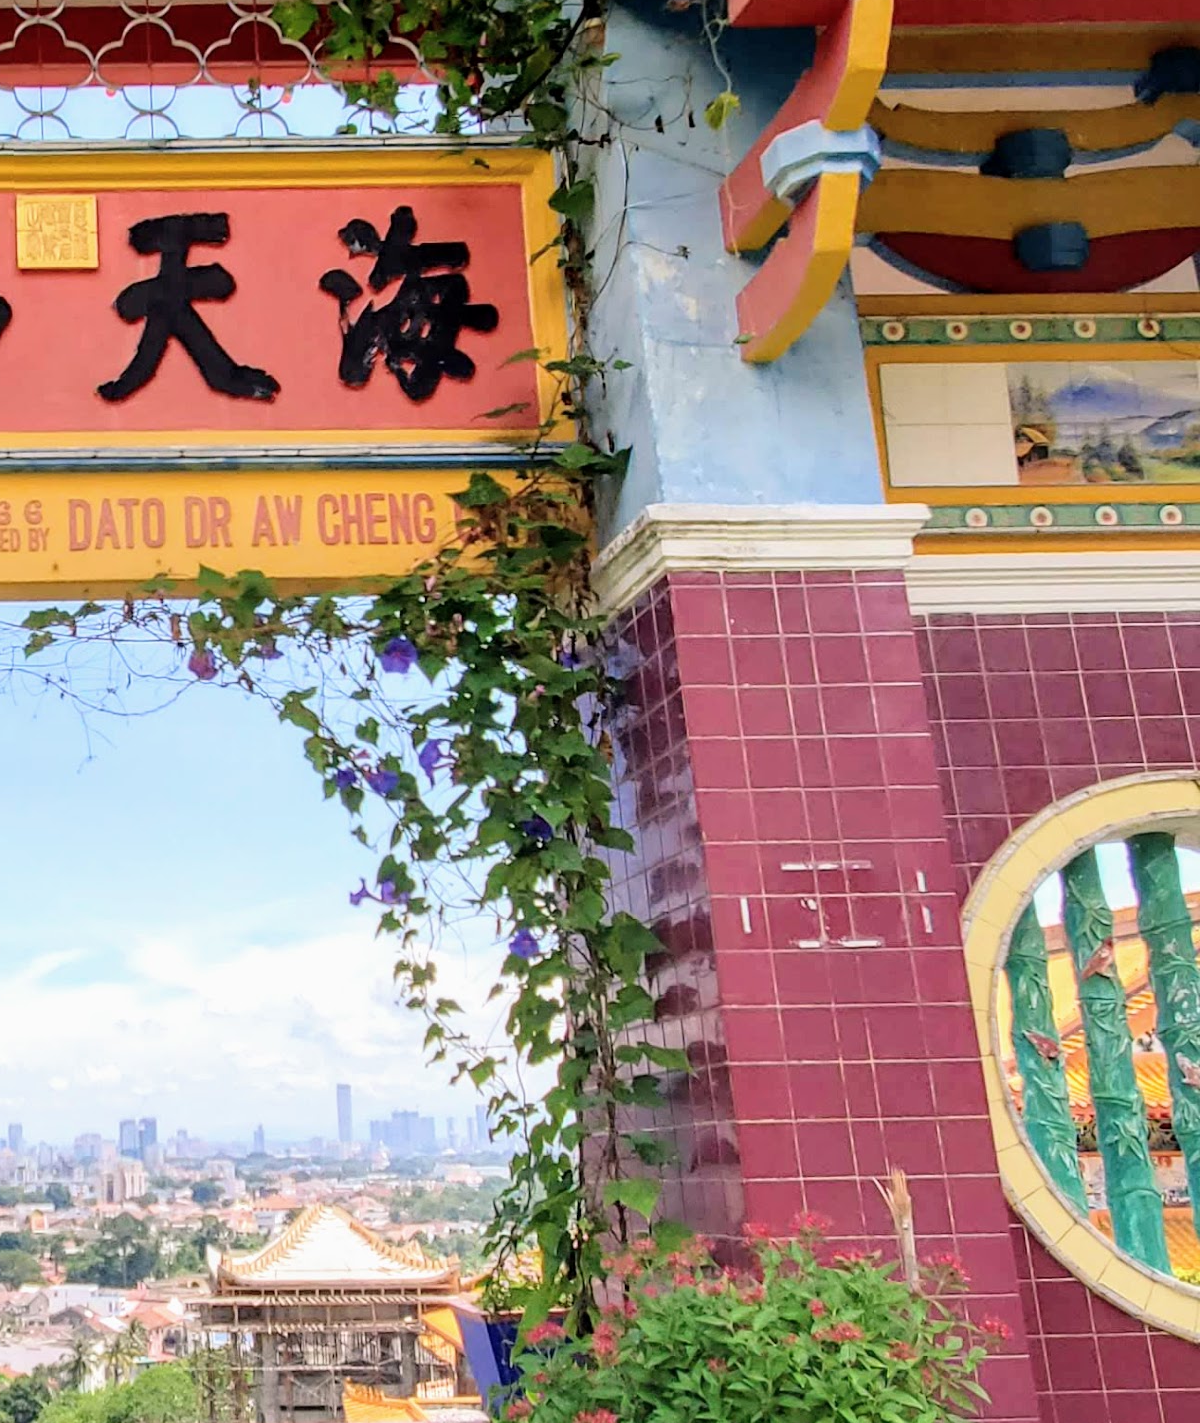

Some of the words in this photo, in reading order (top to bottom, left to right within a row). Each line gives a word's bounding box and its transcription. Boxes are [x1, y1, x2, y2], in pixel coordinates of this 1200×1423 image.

[27, 527, 50, 553] BY
[68, 497, 166, 551] DATO
[184, 496, 233, 548] DR
[251, 495, 302, 547] AW
[317, 492, 437, 545] CHENG
